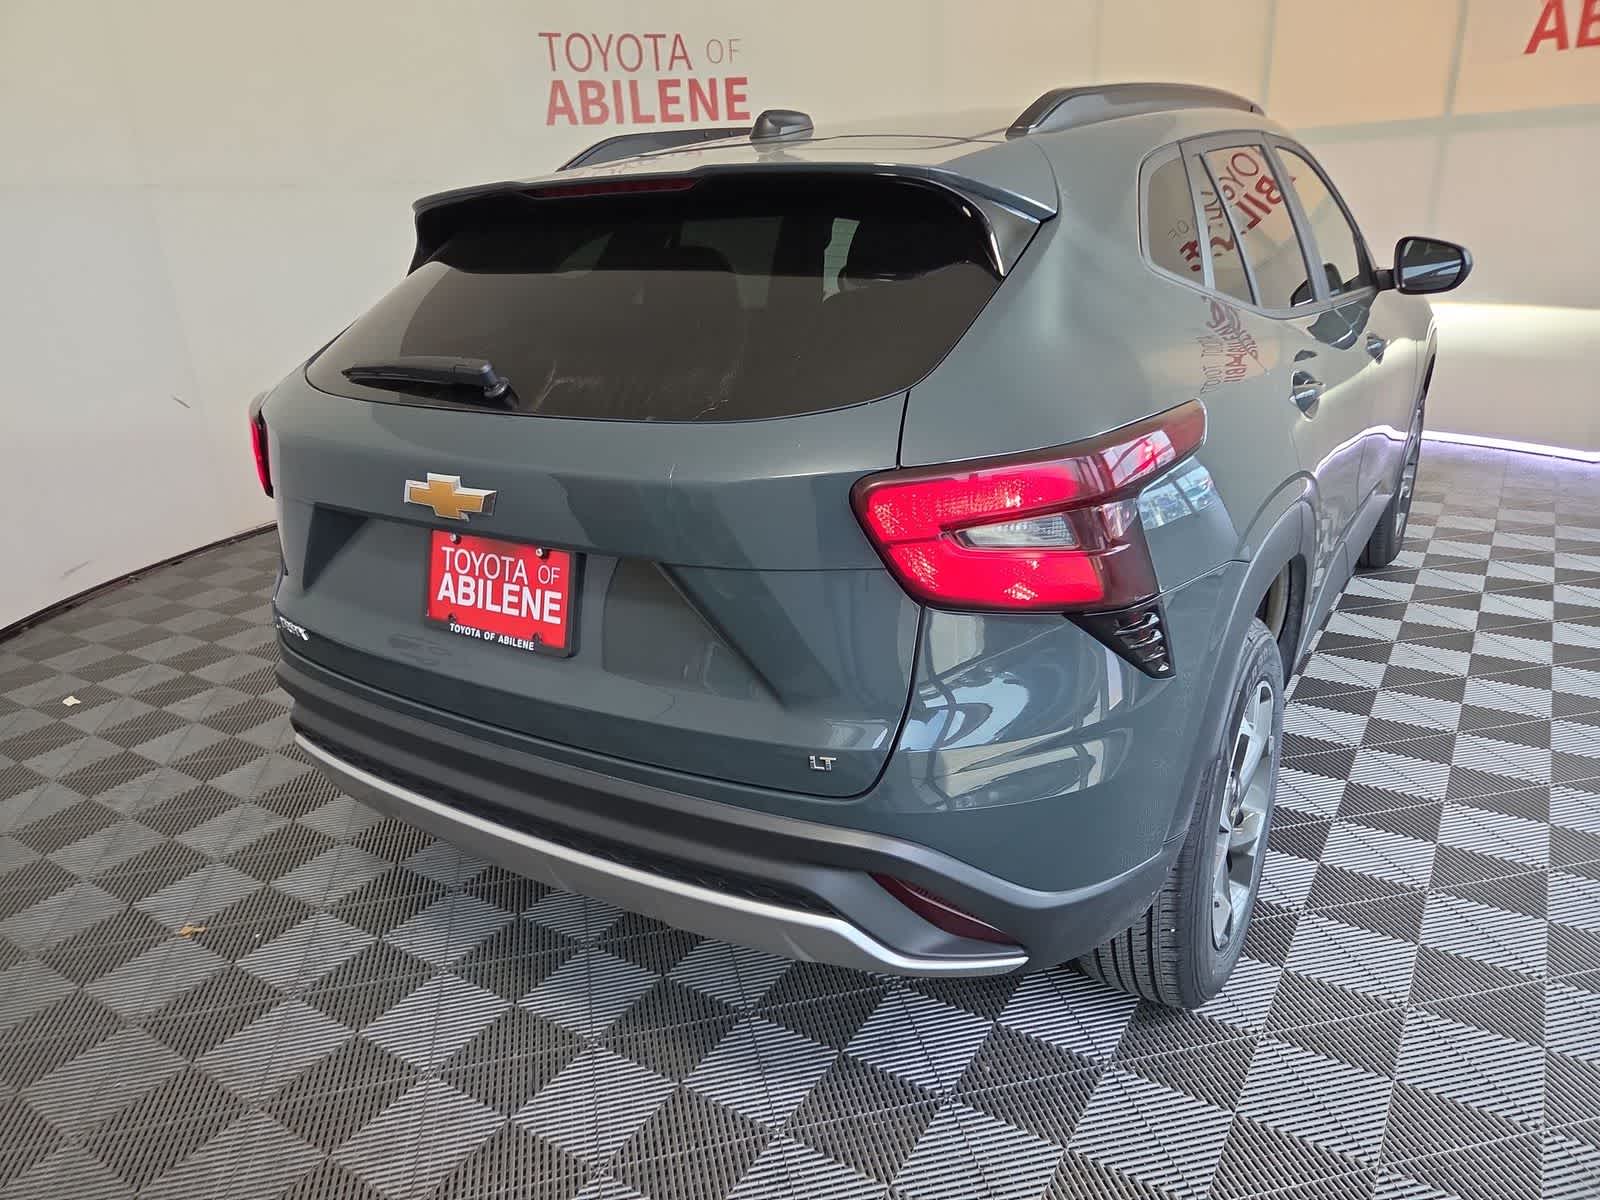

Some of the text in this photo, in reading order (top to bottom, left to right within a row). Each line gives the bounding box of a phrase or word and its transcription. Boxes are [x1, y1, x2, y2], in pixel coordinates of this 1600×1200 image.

[538, 32, 742, 72] TOYOTA OF
[546, 76, 751, 126] ABILENE
[441, 546, 561, 585] TOYOTA OF
[437, 572, 562, 625] ABILENE
[450, 623, 535, 651] TOYOTA OF ABILENE
[809, 755, 837, 771] LT
